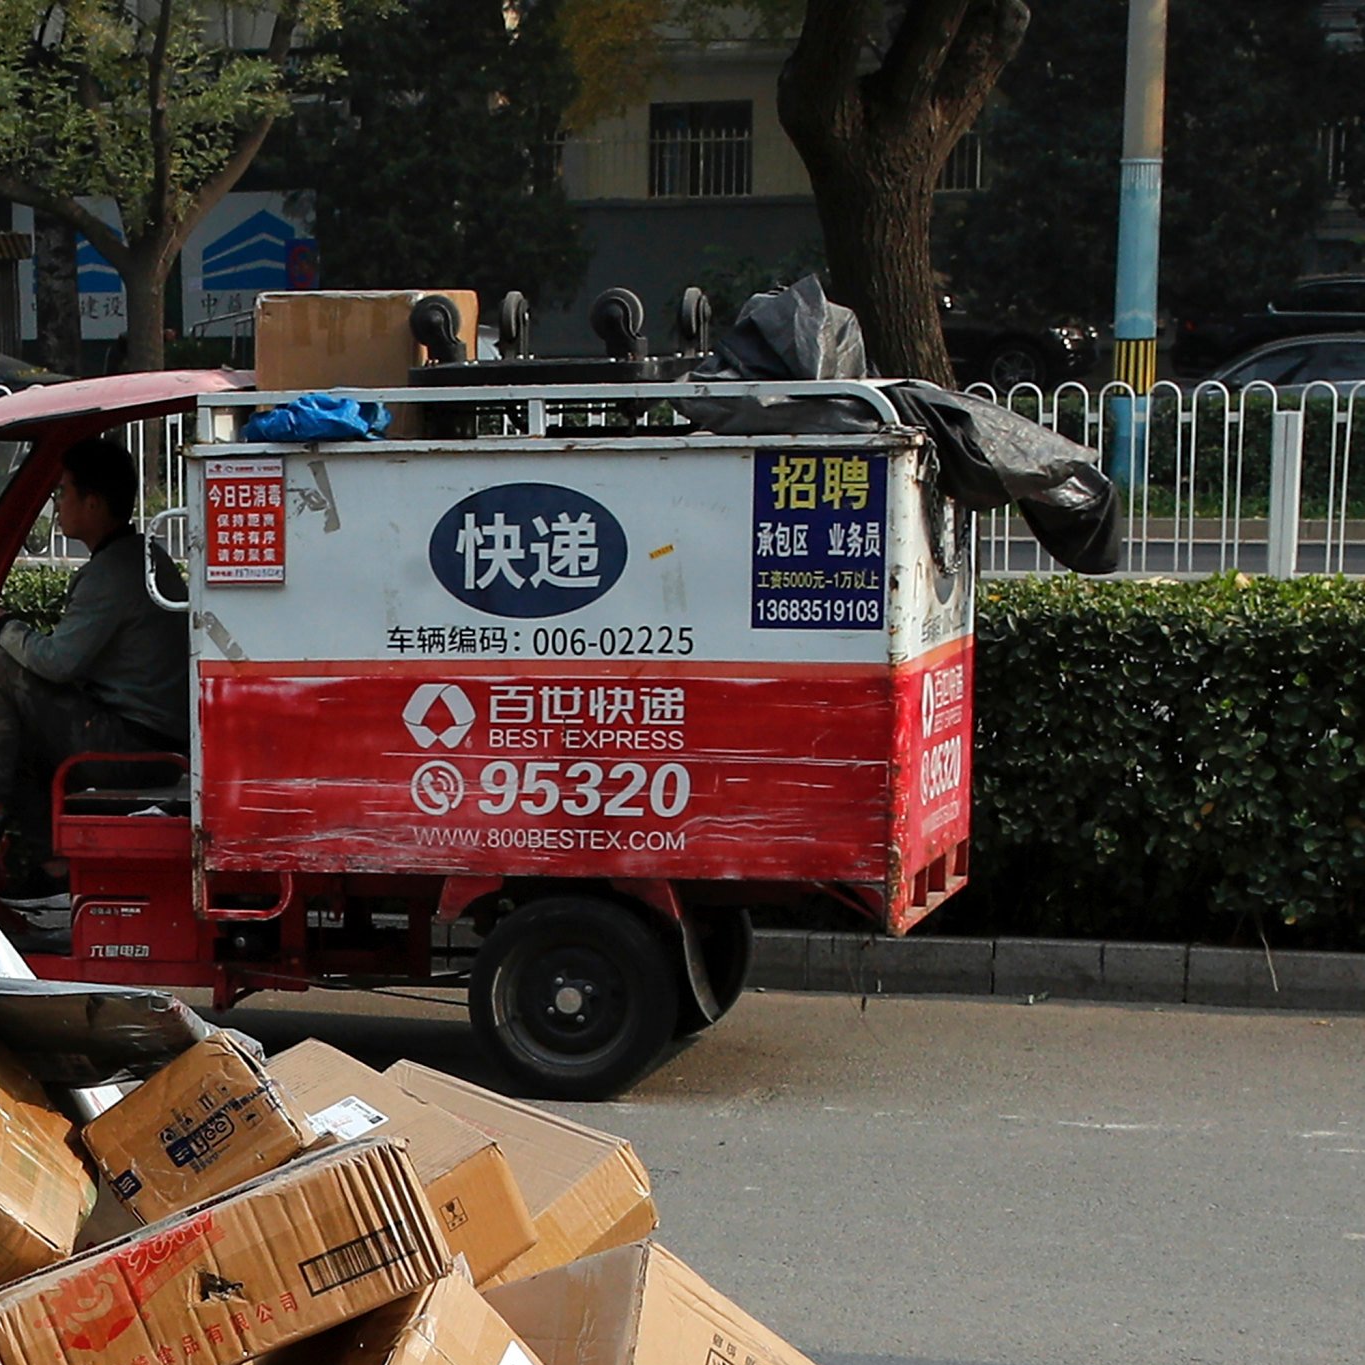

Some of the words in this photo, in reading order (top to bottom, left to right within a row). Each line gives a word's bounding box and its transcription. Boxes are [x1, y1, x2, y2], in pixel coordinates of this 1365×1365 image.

[771, 455, 870, 511] 招聘
[208, 484, 282, 508] 今日已消毒
[217, 513, 275, 527] 保持距离
[217, 530, 276, 545] 取件有序
[757, 522, 809, 557] 承包区
[827, 522, 882, 557] 业务员
[456, 512, 603, 590] 快递
[757, 570, 880, 589] 工资5000元-1万以上
[757, 598, 879, 622] 13683519103
[487, 686, 686, 725] 百世快递
[489, 729, 554, 750] BEST
[564, 729, 685, 750] EXPRESS
[478, 762, 691, 818] 95320
[413, 828, 686, 852] WWW.800BESTEX.COM
